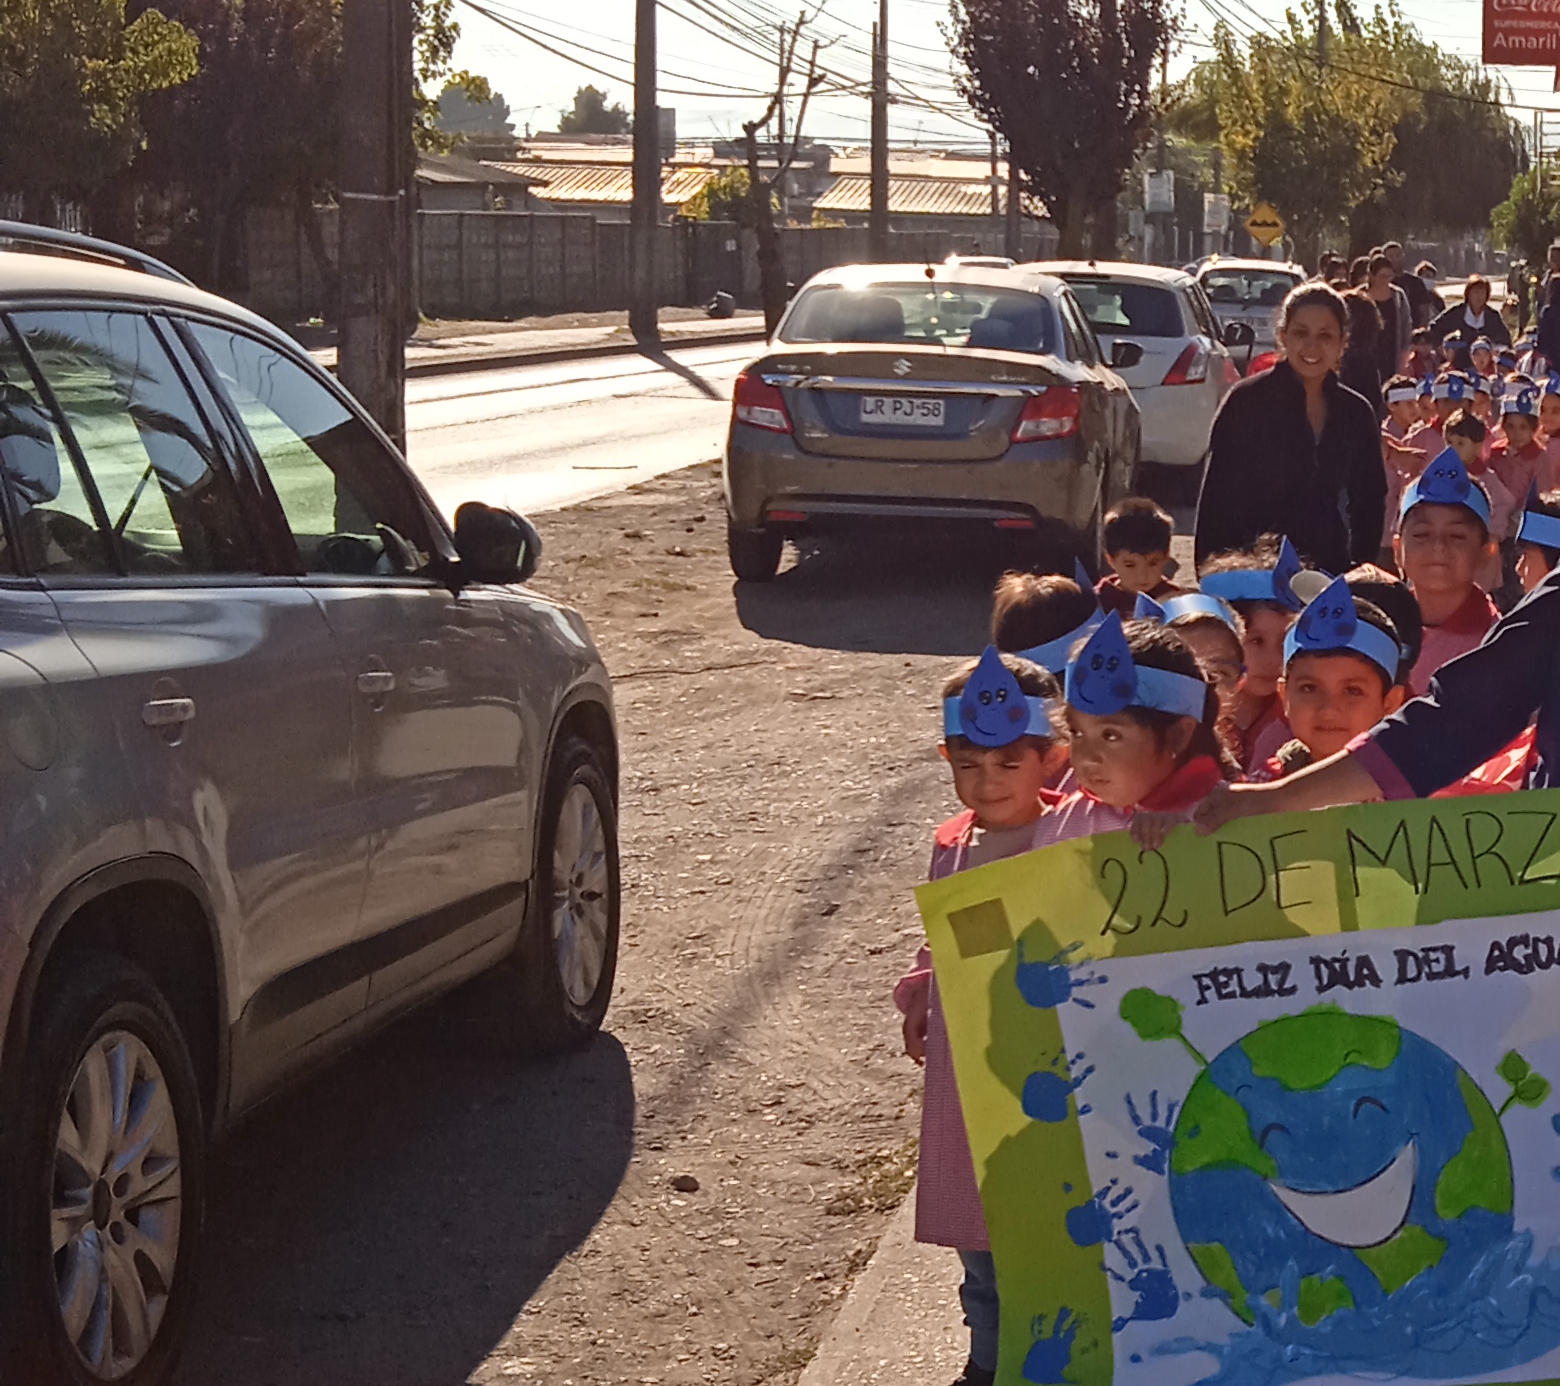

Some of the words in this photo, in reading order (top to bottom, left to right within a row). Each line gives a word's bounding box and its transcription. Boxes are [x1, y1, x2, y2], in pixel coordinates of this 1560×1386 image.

[1493, 19, 1560, 30] SUPERMERCA
[863, 398, 885, 415] LR
[1099, 849, 1188, 936] 22
[1217, 829, 1312, 917] DE
[1192, 960, 1298, 1006] FELIZ
[1309, 949, 1384, 995] DÍA
[1393, 944, 1471, 987] DEL
